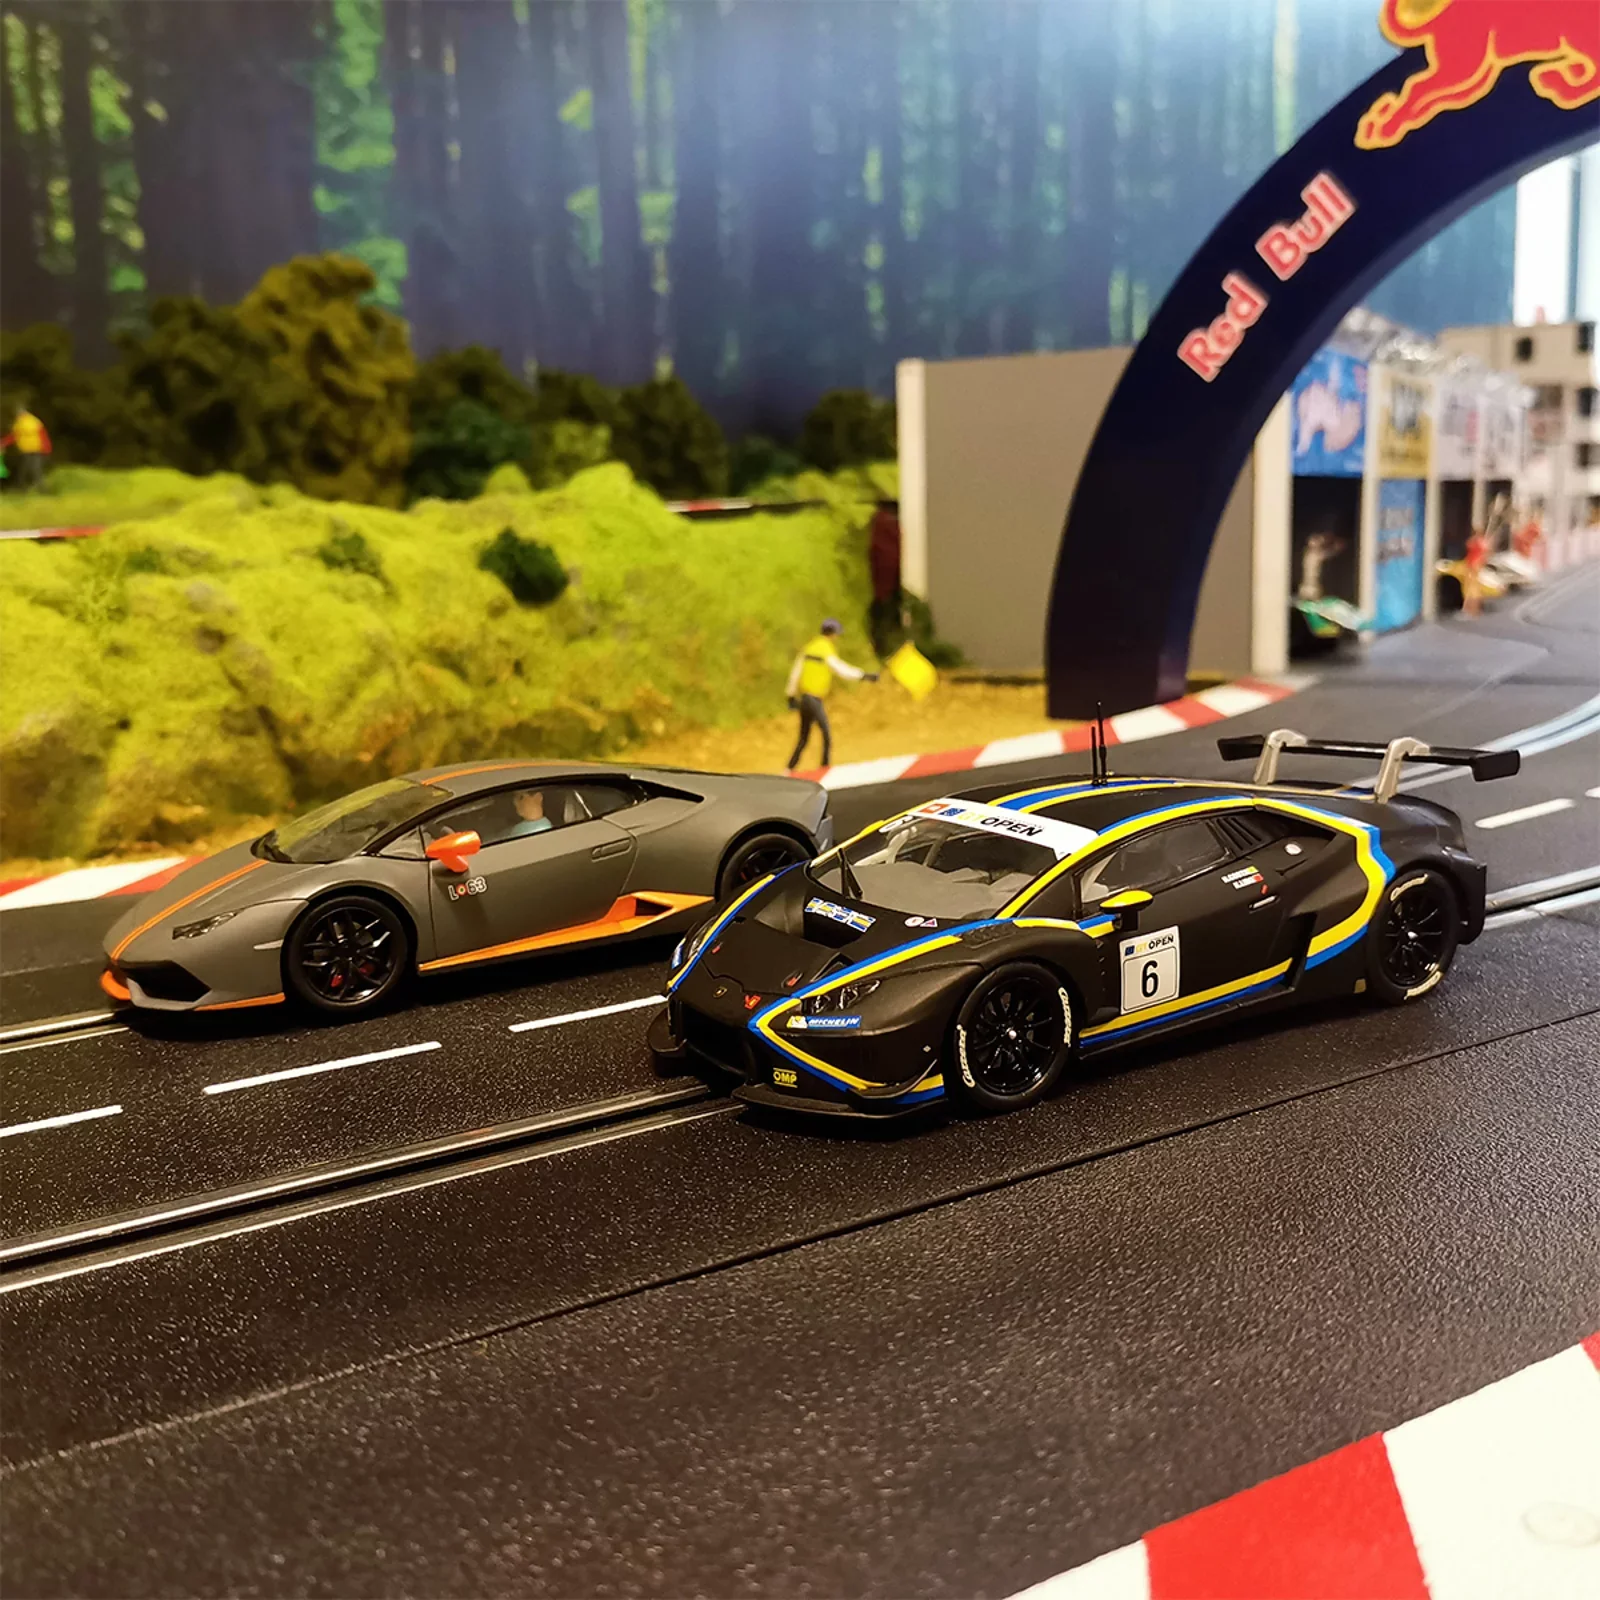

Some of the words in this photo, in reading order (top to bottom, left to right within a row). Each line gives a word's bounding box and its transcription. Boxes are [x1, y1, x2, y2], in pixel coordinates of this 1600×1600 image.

[1177, 272, 1269, 383] Red
[1255, 170, 1357, 281] Bull
[980, 816, 1043, 837] OPEN
[1148, 934, 1175, 950] OPEN
[1141, 960, 1159, 998] 6
[808, 1017, 860, 1027] MICHELIN
[773, 1071, 797, 1084] OMP
